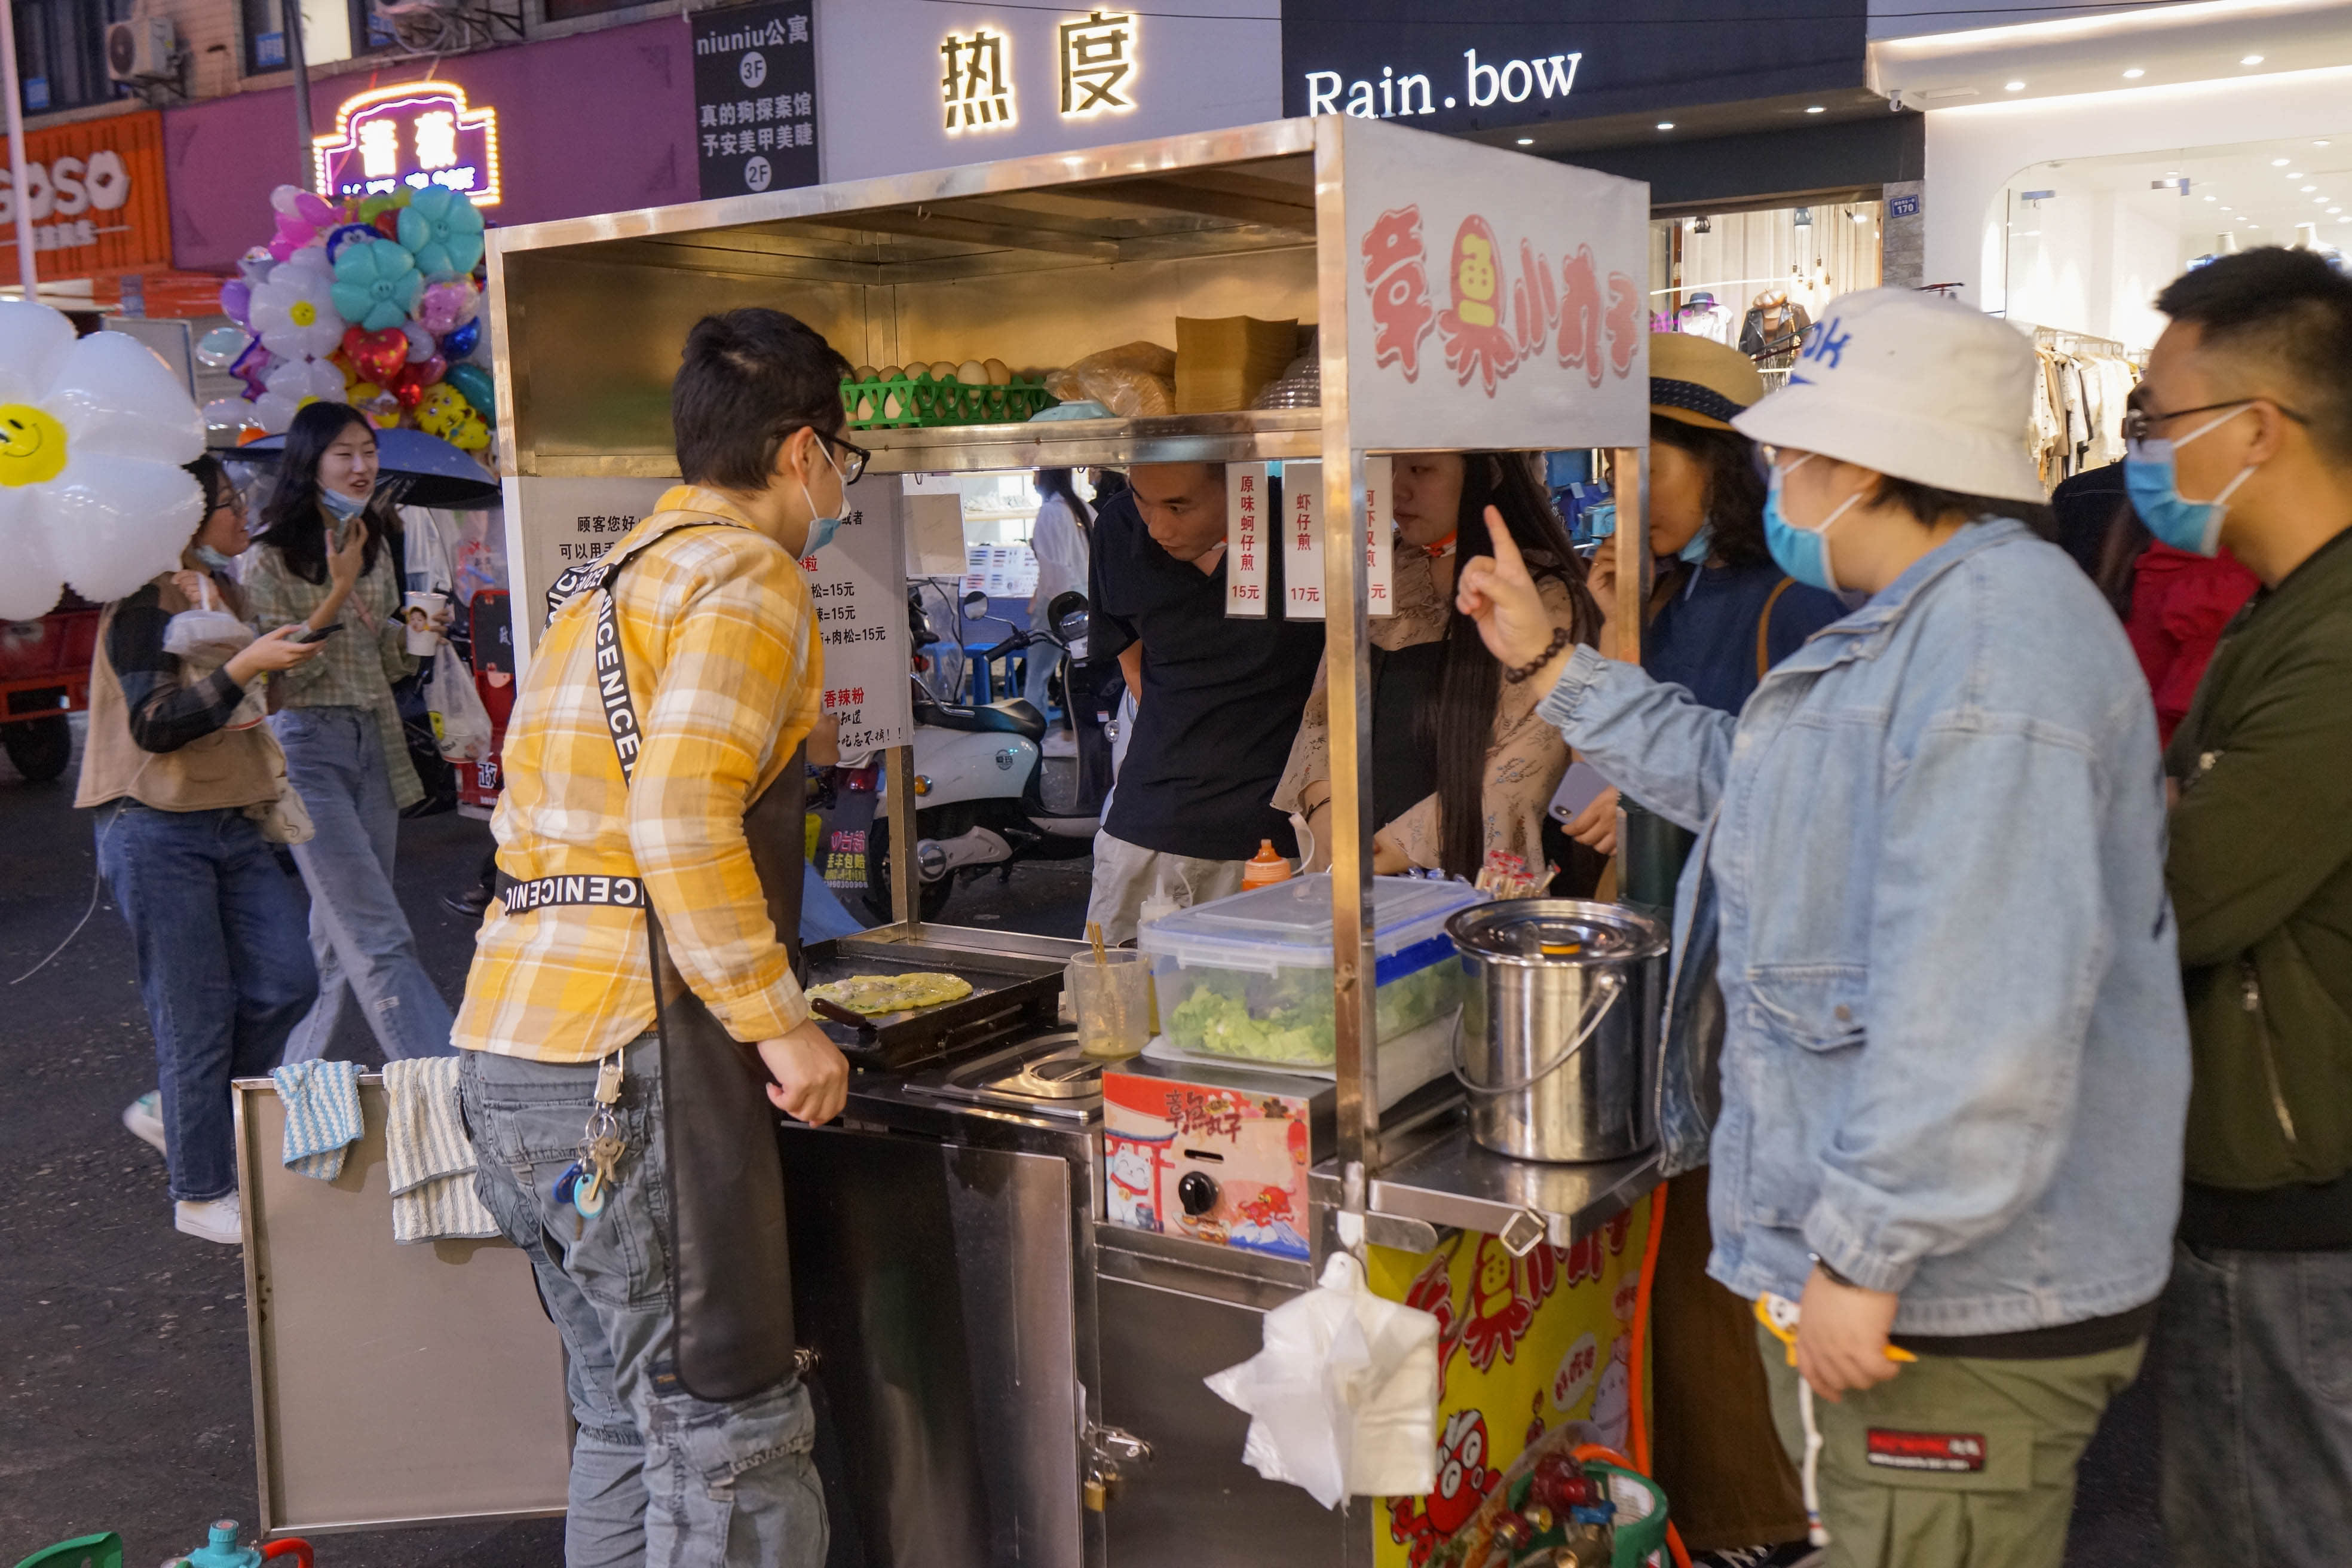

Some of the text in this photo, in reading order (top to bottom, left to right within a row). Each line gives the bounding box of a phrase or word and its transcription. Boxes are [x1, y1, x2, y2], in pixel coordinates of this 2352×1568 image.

[697, 14, 808, 55] niuniu公寓
[743, 60, 763, 80] 3F
[941, 11, 1131, 129] 热度
[1305, 48, 1582, 120] Rain.bow
[700, 91, 812, 128] 真的狗探案馆
[702, 122, 814, 157] 予安美甲美睫
[749, 164, 767, 183] 2F
[1898, 203, 1914, 214] 170
[1241, 476, 1254, 571] 原味蚵仔煎
[1297, 493, 1312, 550] 虾仔煎
[1233, 585, 1260, 599] 15元
[1291, 587, 1319, 602] 17元
[820, 626, 886, 646] +肉松=15元
[824, 687, 864, 708] 香辣粉
[829, 709, 862, 726] 知道
